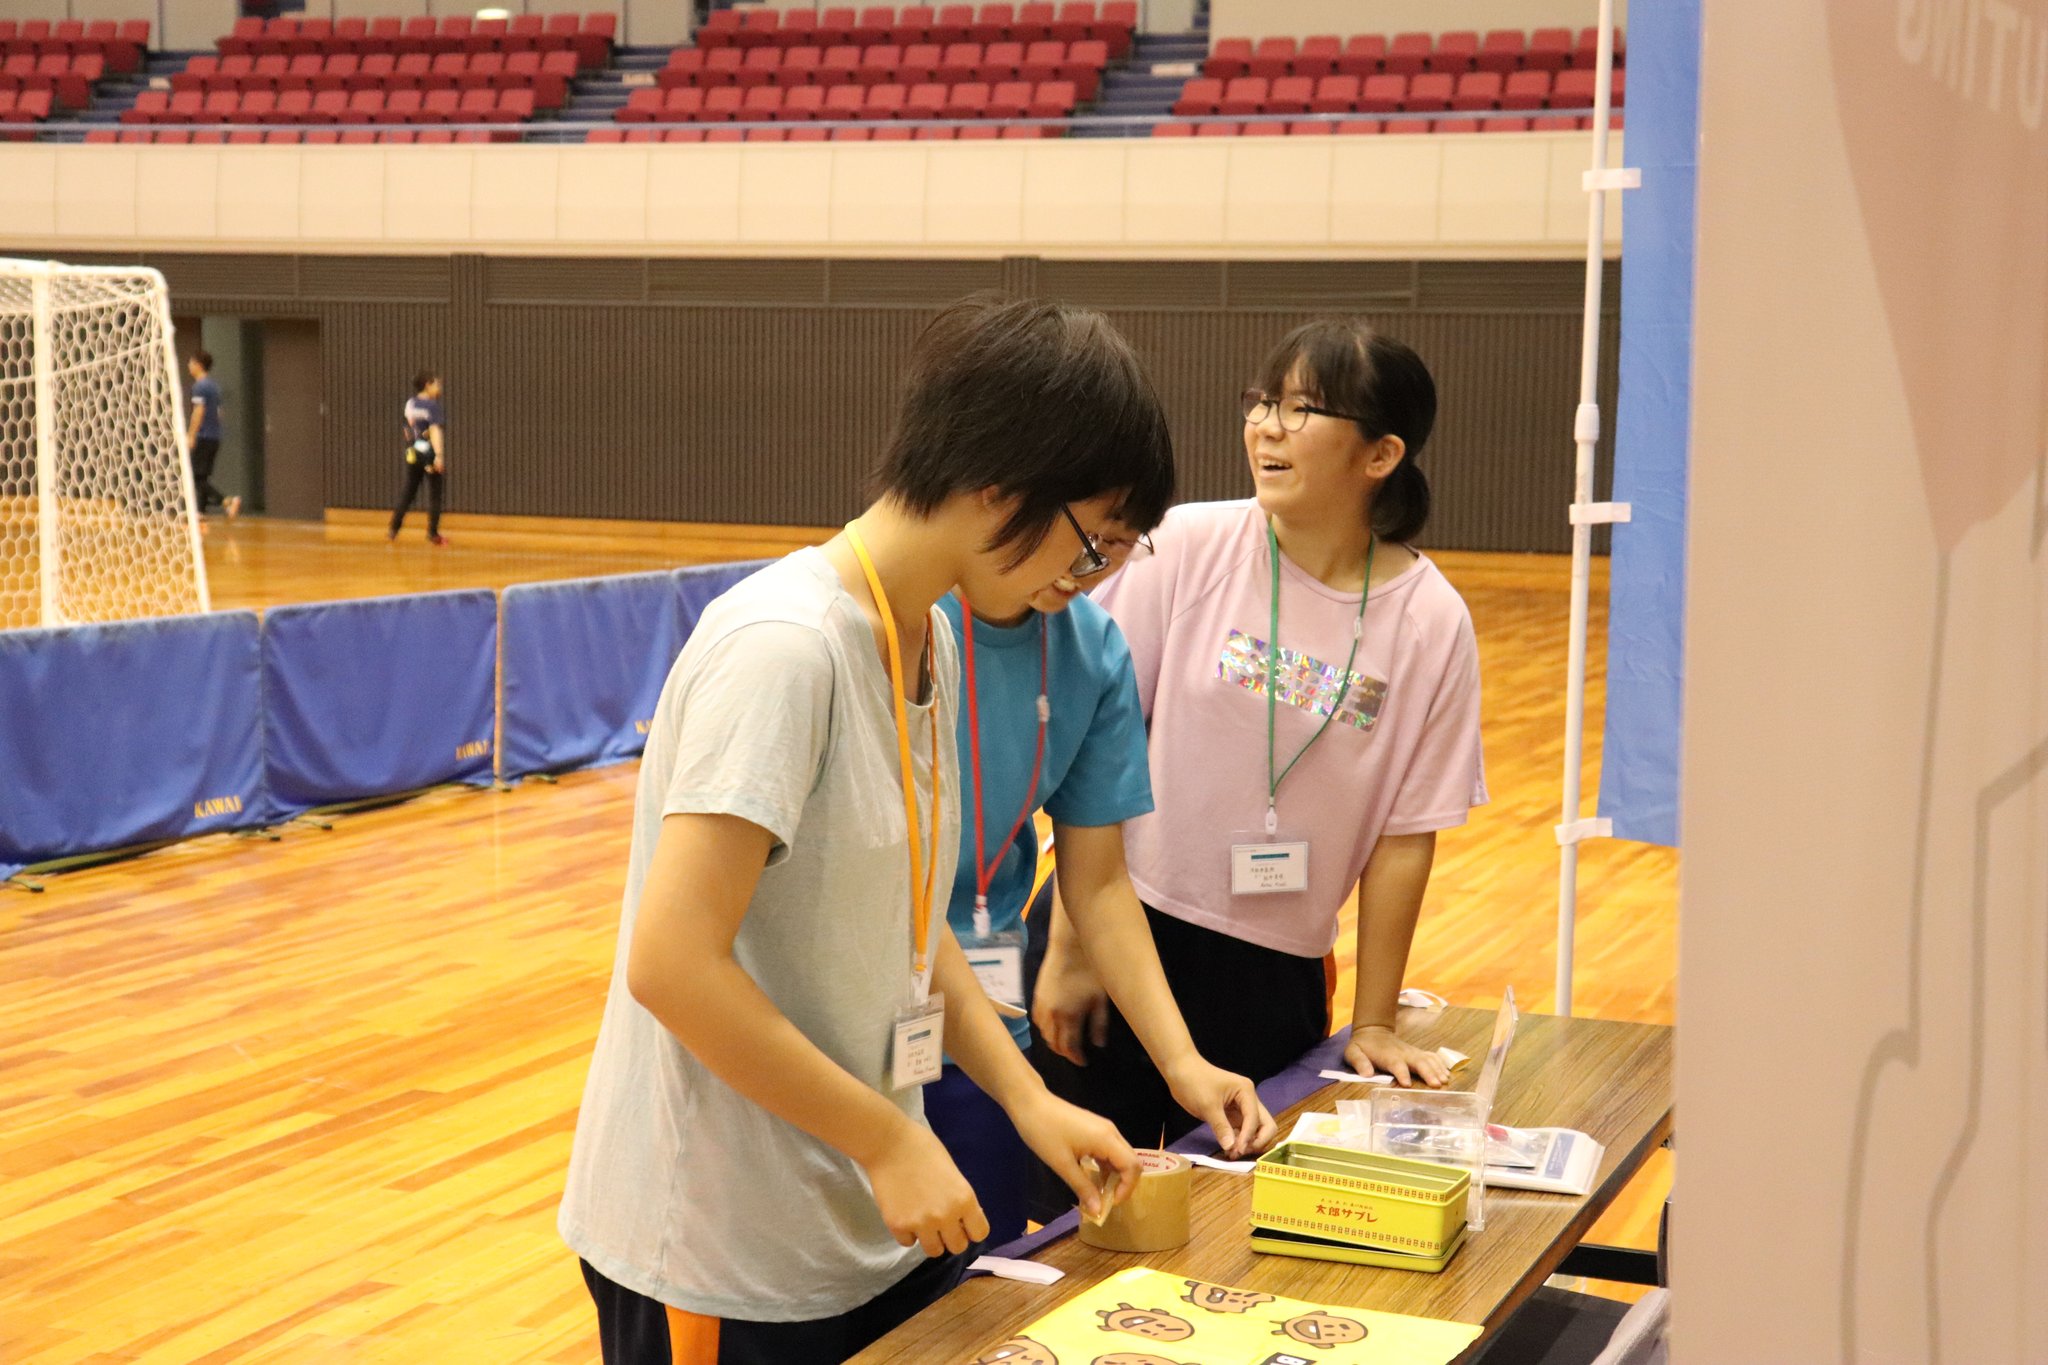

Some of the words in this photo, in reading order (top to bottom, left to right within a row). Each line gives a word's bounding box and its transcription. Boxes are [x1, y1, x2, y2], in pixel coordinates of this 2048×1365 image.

[194, 794, 243, 819] KAWAI
[1315, 1204, 1378, 1223] 太郎サブレ
